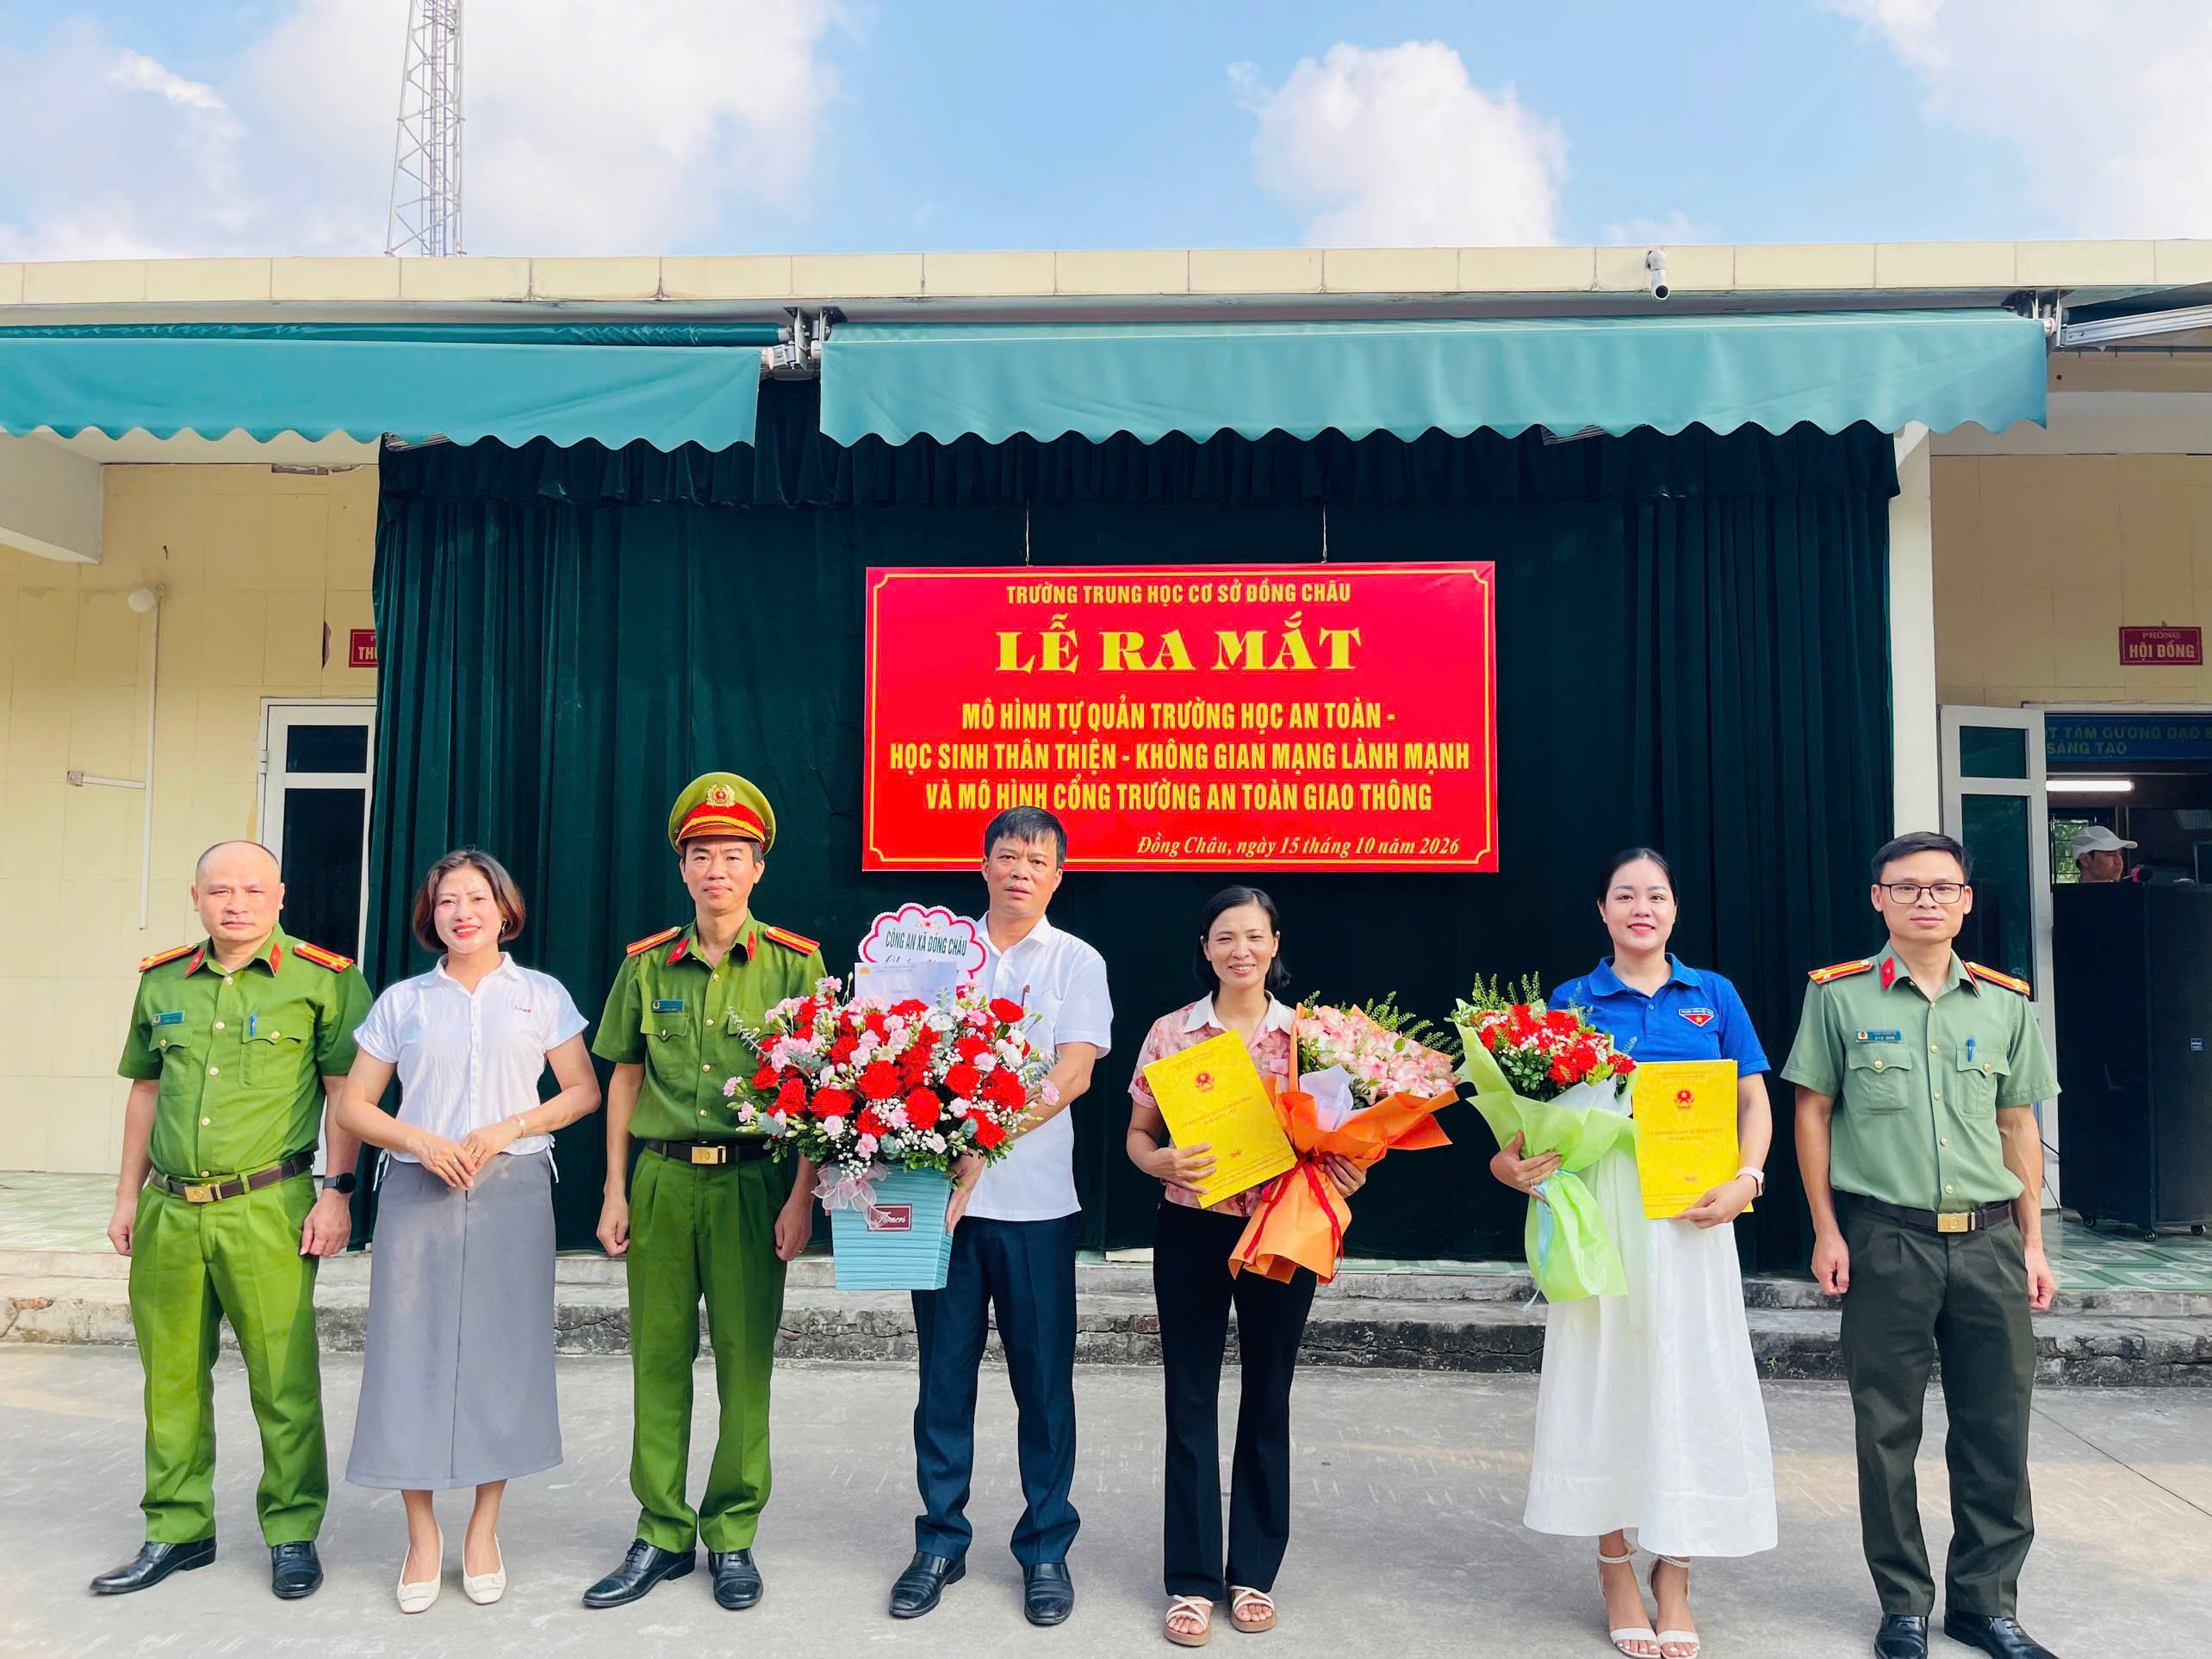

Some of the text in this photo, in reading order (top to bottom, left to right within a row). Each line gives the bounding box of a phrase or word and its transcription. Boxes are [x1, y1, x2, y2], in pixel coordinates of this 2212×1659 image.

[1007, 578, 1351, 606] TRƯỜNG TRUNG HỌC CƠ SỞ ĐỒNG CHÂU
[995, 611, 1362, 674] LỄ RA MẮT
[2142, 630, 2181, 639] PHÒNG
[2129, 640, 2196, 661] HỘI ĐỒNG
[962, 698, 995, 730] MÔ
[1000, 698, 1051, 730] HÌNH
[1056, 701, 1084, 735] TỰ
[1088, 693, 1145, 731] QUẢN
[1150, 697, 1235, 730] TRƯỜNG
[1241, 702, 1283, 735] HỌC
[1289, 702, 1319, 729] AN
[1325, 697, 1381, 729] TOÀN
[890, 743, 932, 775] HỌC
[938, 743, 988, 769] SINH
[994, 738, 1049, 769] THÂN
[1054, 738, 1116, 775] THIỆN
[1136, 738, 1209, 769] KHÔNG
[1214, 743, 1265, 770] GIAN
[1271, 743, 1336, 775] MẠNG
[1341, 737, 1398, 769] LÀNH
[1404, 743, 1469, 775] MẠNH
[926, 774, 1432, 811] VÀ MÔ HÌNH CỔNG TRƯỜNG AN TOÀN GIAO THÔNG
[1137, 831, 1460, 859] Đồng Châu, ngày 15 tháng 10 năm 2026
[885, 928, 905, 948] CÔNG
[905, 933, 917, 951] AN
